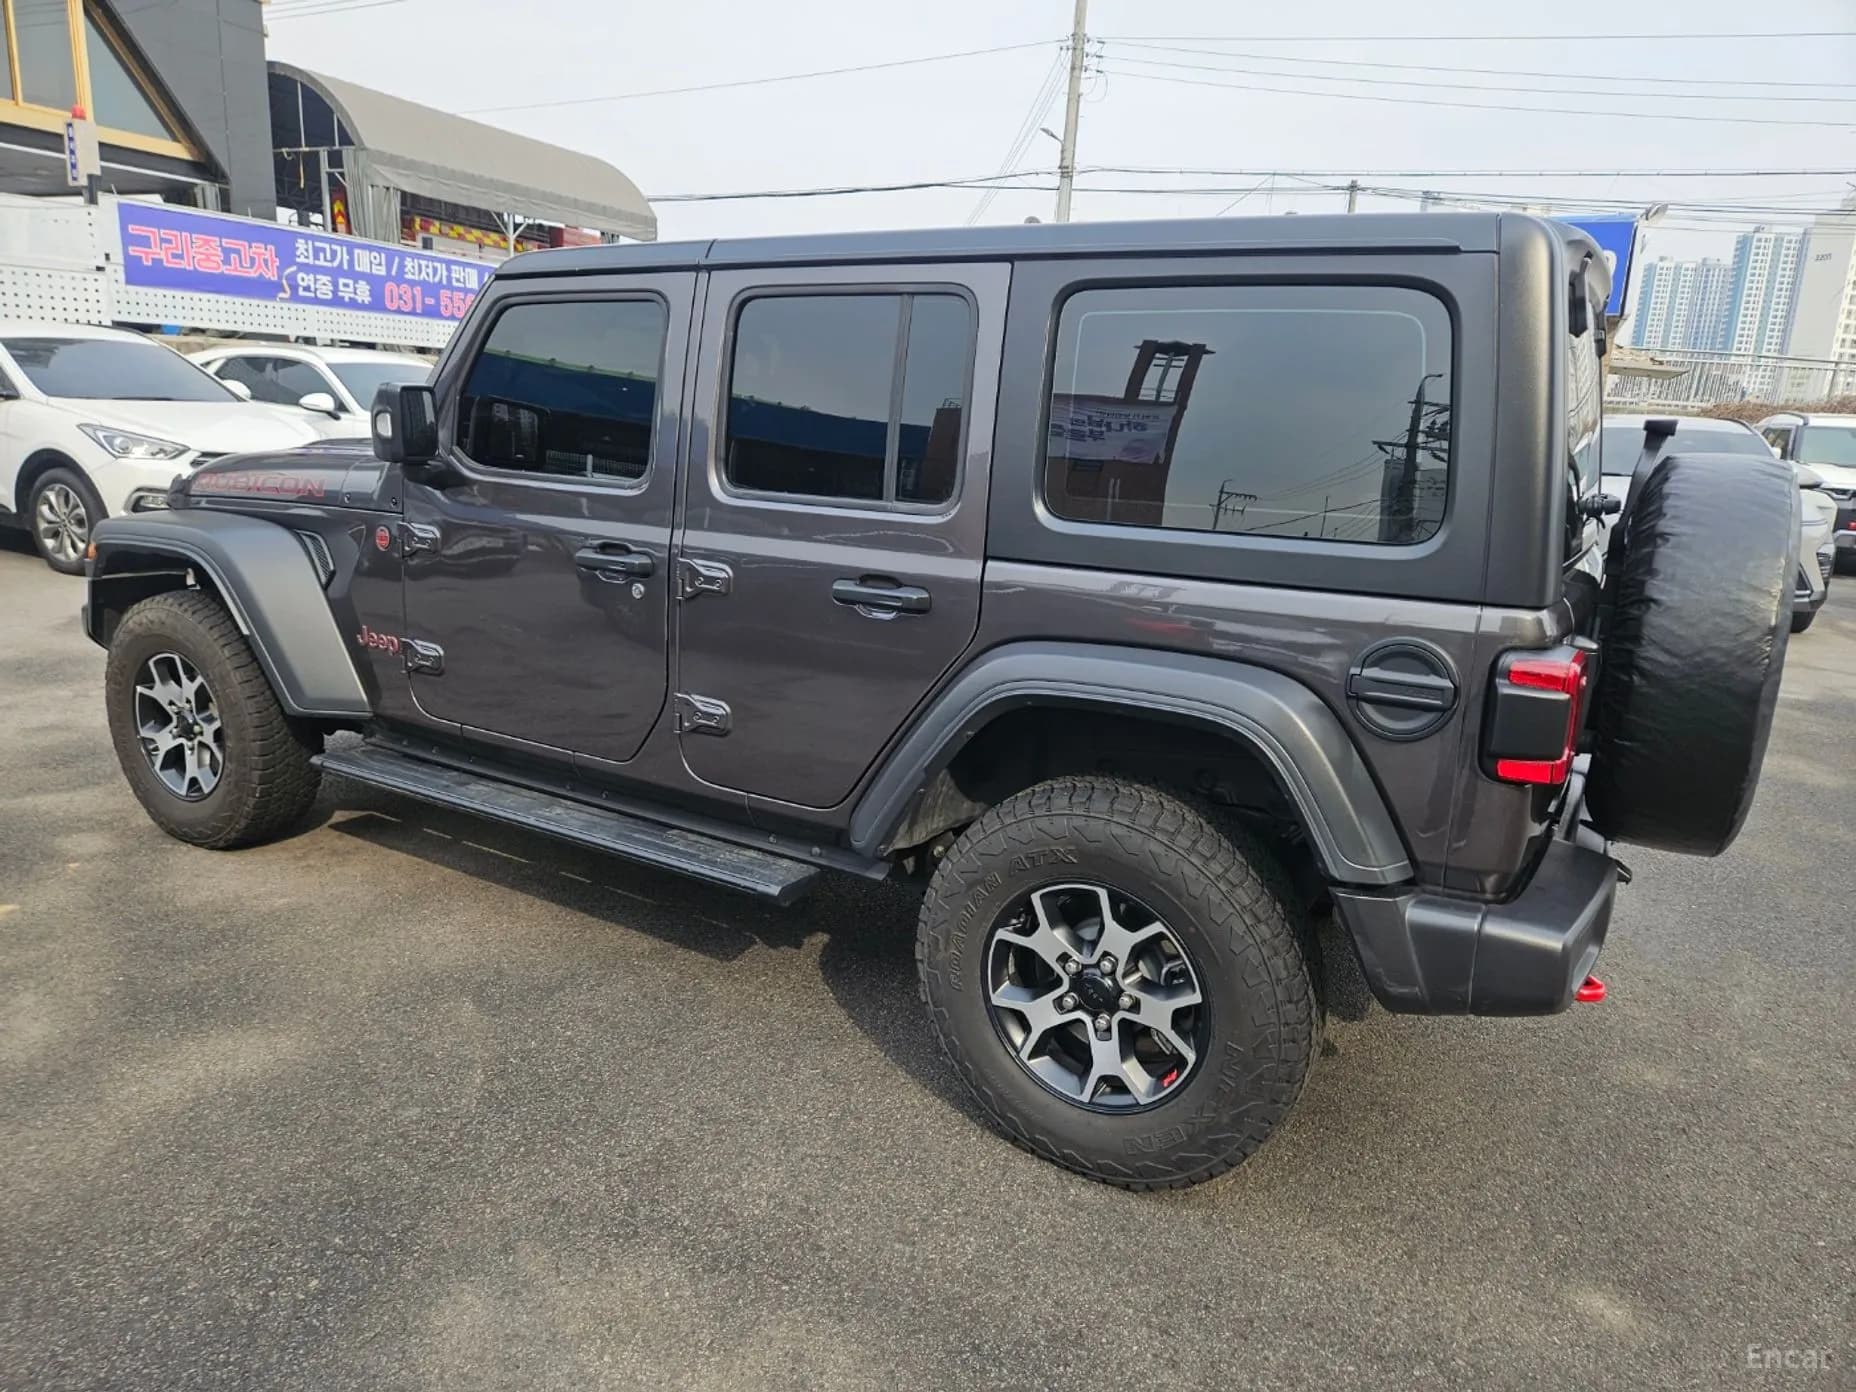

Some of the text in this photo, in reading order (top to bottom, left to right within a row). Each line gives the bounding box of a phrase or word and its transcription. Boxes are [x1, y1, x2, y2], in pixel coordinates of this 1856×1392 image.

[128, 224, 279, 281] 구리중고차
[295, 238, 350, 271] 최고가
[353, 248, 387, 276] 매입
[404, 257, 448, 286] 최저가
[450, 265, 479, 290] 판매
[297, 271, 333, 300] 연중
[337, 277, 372, 304] 무휴
[193, 472, 327, 497] RUBICON
[357, 625, 400, 656] Jeep
[950, 848, 1079, 992] ROADIAN ATX
